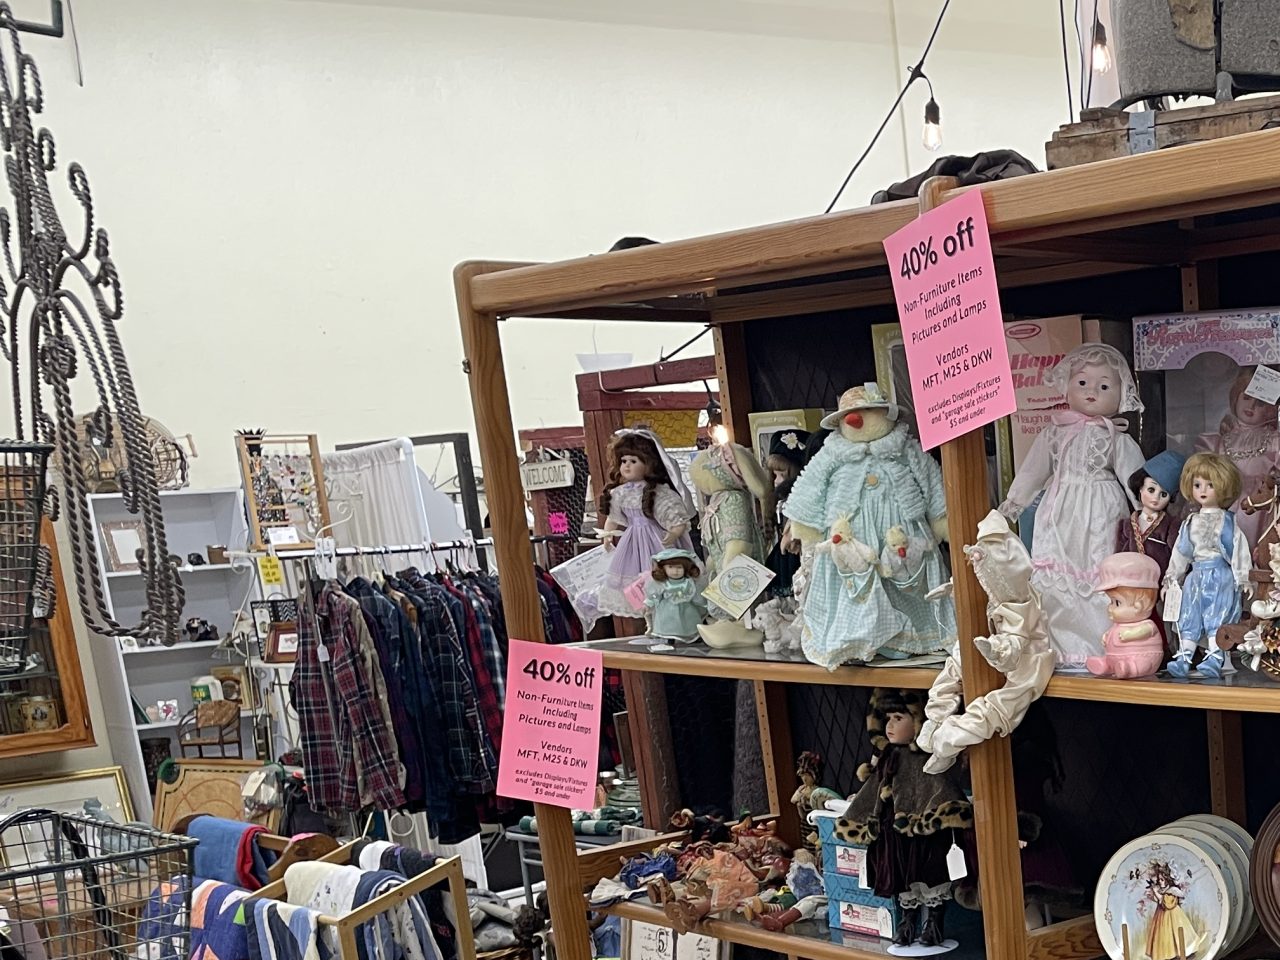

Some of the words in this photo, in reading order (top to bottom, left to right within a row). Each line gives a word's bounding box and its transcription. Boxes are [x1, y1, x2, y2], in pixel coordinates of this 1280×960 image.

[900, 236, 938, 280] 40%
[943, 216, 975, 257] off
[903, 278, 957, 314] Non-Furniture
[957, 266, 983, 286] Items
[924, 294, 961, 320] Including
[911, 320, 942, 345] Pictures
[941, 313, 959, 330] and
[959, 301, 987, 322] Lamps
[935, 343, 969, 366] Vendors
[922, 371, 943, 391] MFT,
[943, 362, 963, 383] M25
[963, 361, 970, 373] &
[970, 347, 993, 369] DKW
[927, 398, 952, 414] excludes
[931, 412, 942, 425] and
[964, 399, 976, 414] sale
[949, 416, 958, 429] $5
[958, 413, 969, 425] and
[969, 407, 986, 422] under
[522, 658, 572, 686] 40%
[574, 667, 595, 690] off
[516, 690, 578, 709] Non-Furniture
[578, 699, 594, 711] Items
[518, 713, 556, 729] Pictures
[557, 720, 572, 731] and
[572, 721, 592, 735] Lamps
[542, 706, 578, 721] Including
[516, 748, 540, 763] MFT,
[543, 752, 562, 765] M25
[562, 756, 569, 766] &
[570, 757, 588, 769] DKW
[540, 741, 573, 755] Vendors
[515, 768, 543, 779] excludes
[515, 776, 529, 784] and
[534, 786, 544, 795] $5
